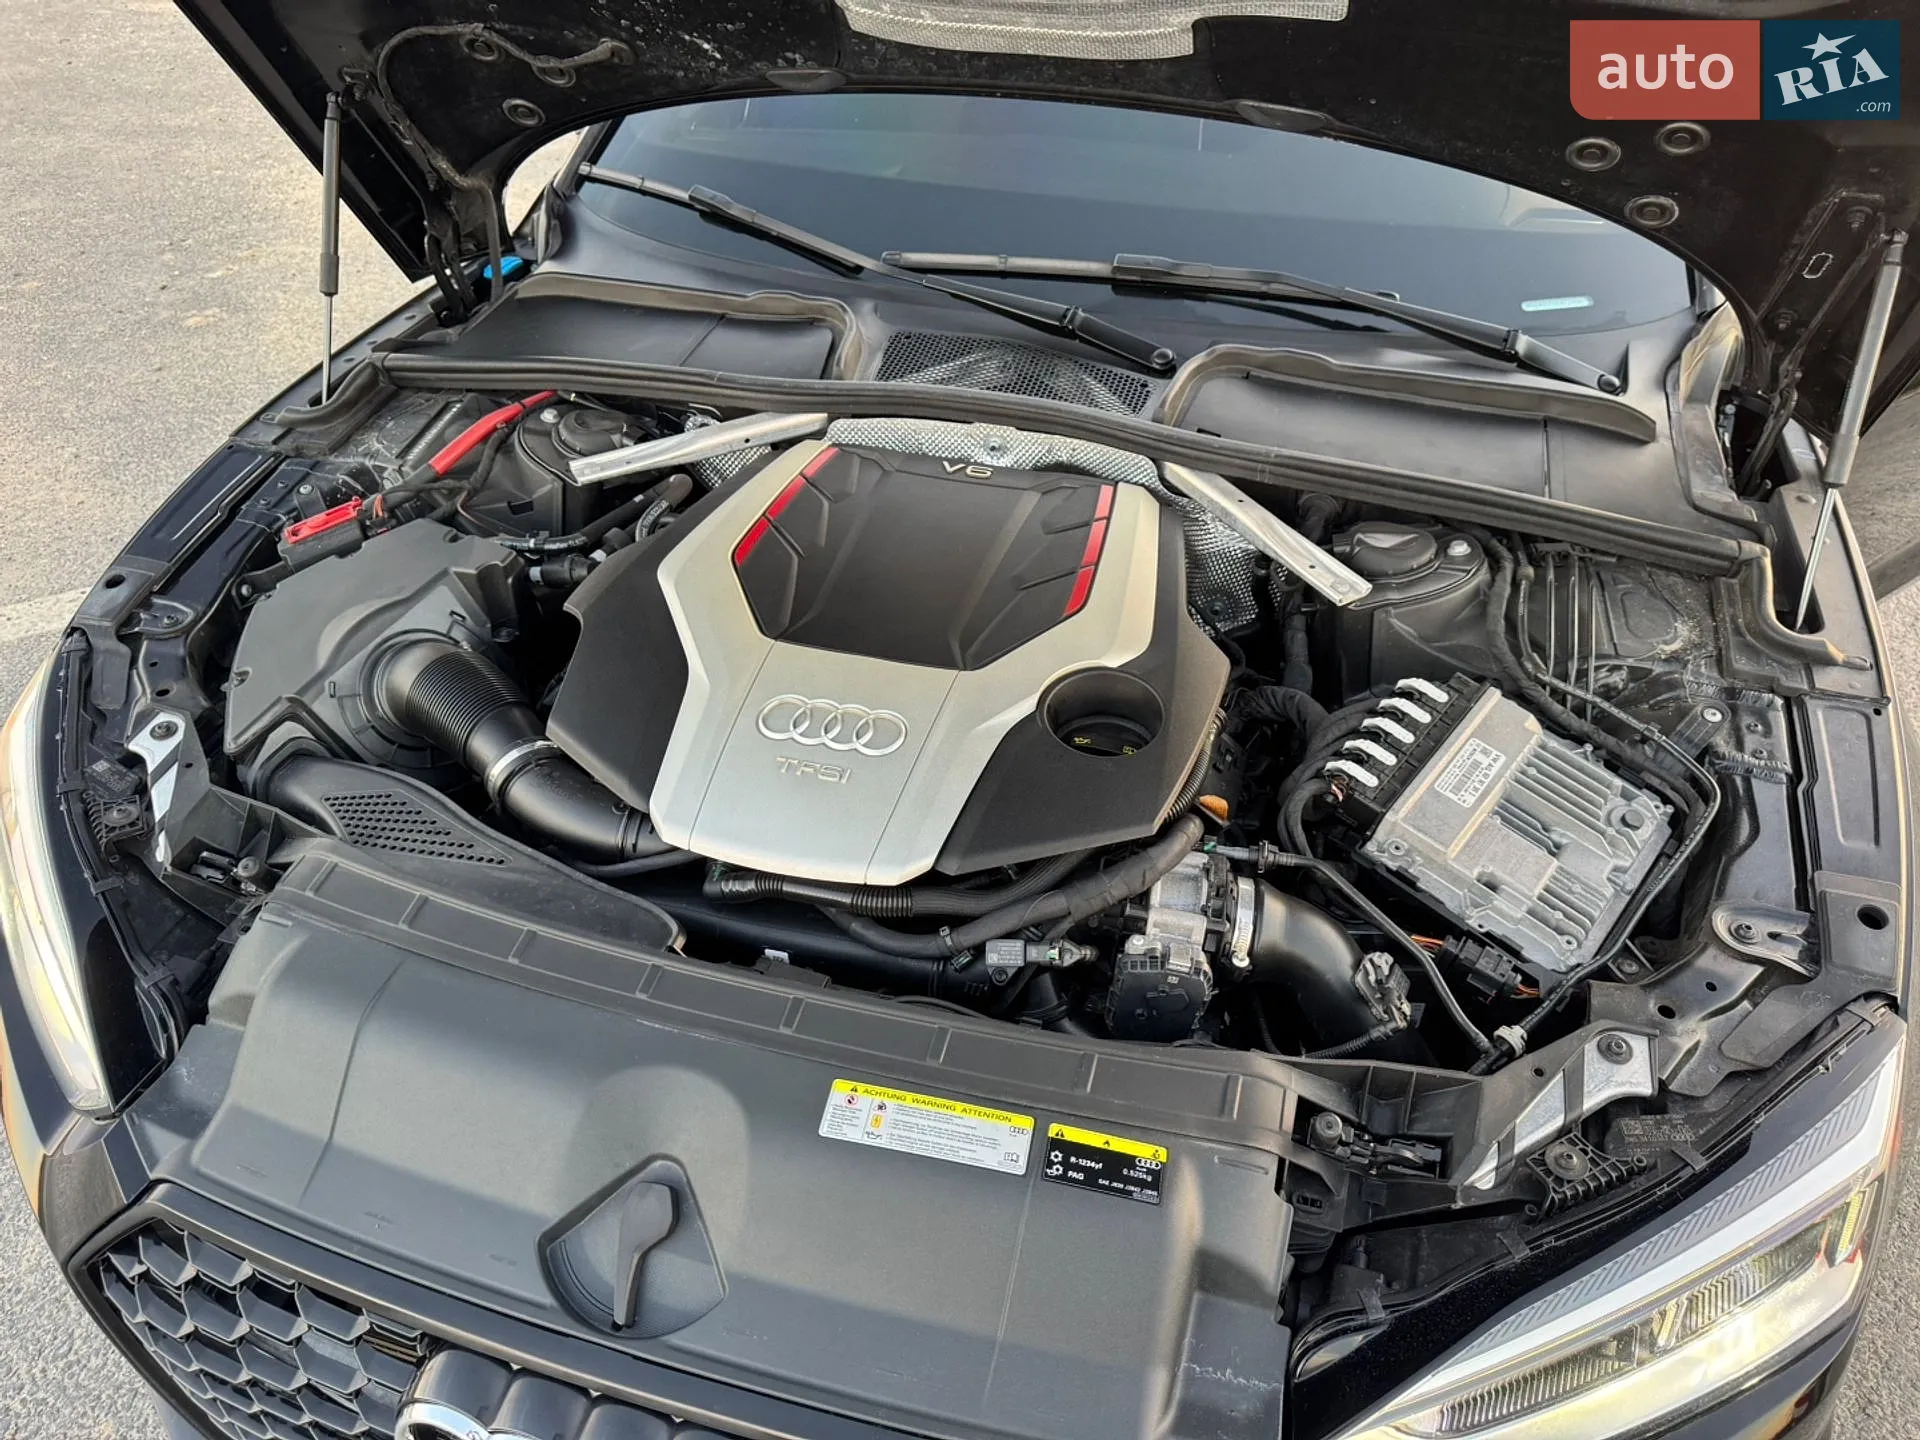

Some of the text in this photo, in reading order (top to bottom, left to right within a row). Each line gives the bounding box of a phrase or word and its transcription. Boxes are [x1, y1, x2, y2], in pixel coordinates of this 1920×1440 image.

[942, 460, 994, 479] V6
[776, 756, 851, 784] TFSI
[862, 1088, 907, 1103] ACHTUNG
[911, 1098, 957, 1113] WARNING
[961, 1107, 1013, 1124] ATTENTION
[1070, 1156, 1103, 1170] R-1234yf
[1067, 1170, 1085, 1181] PAG
